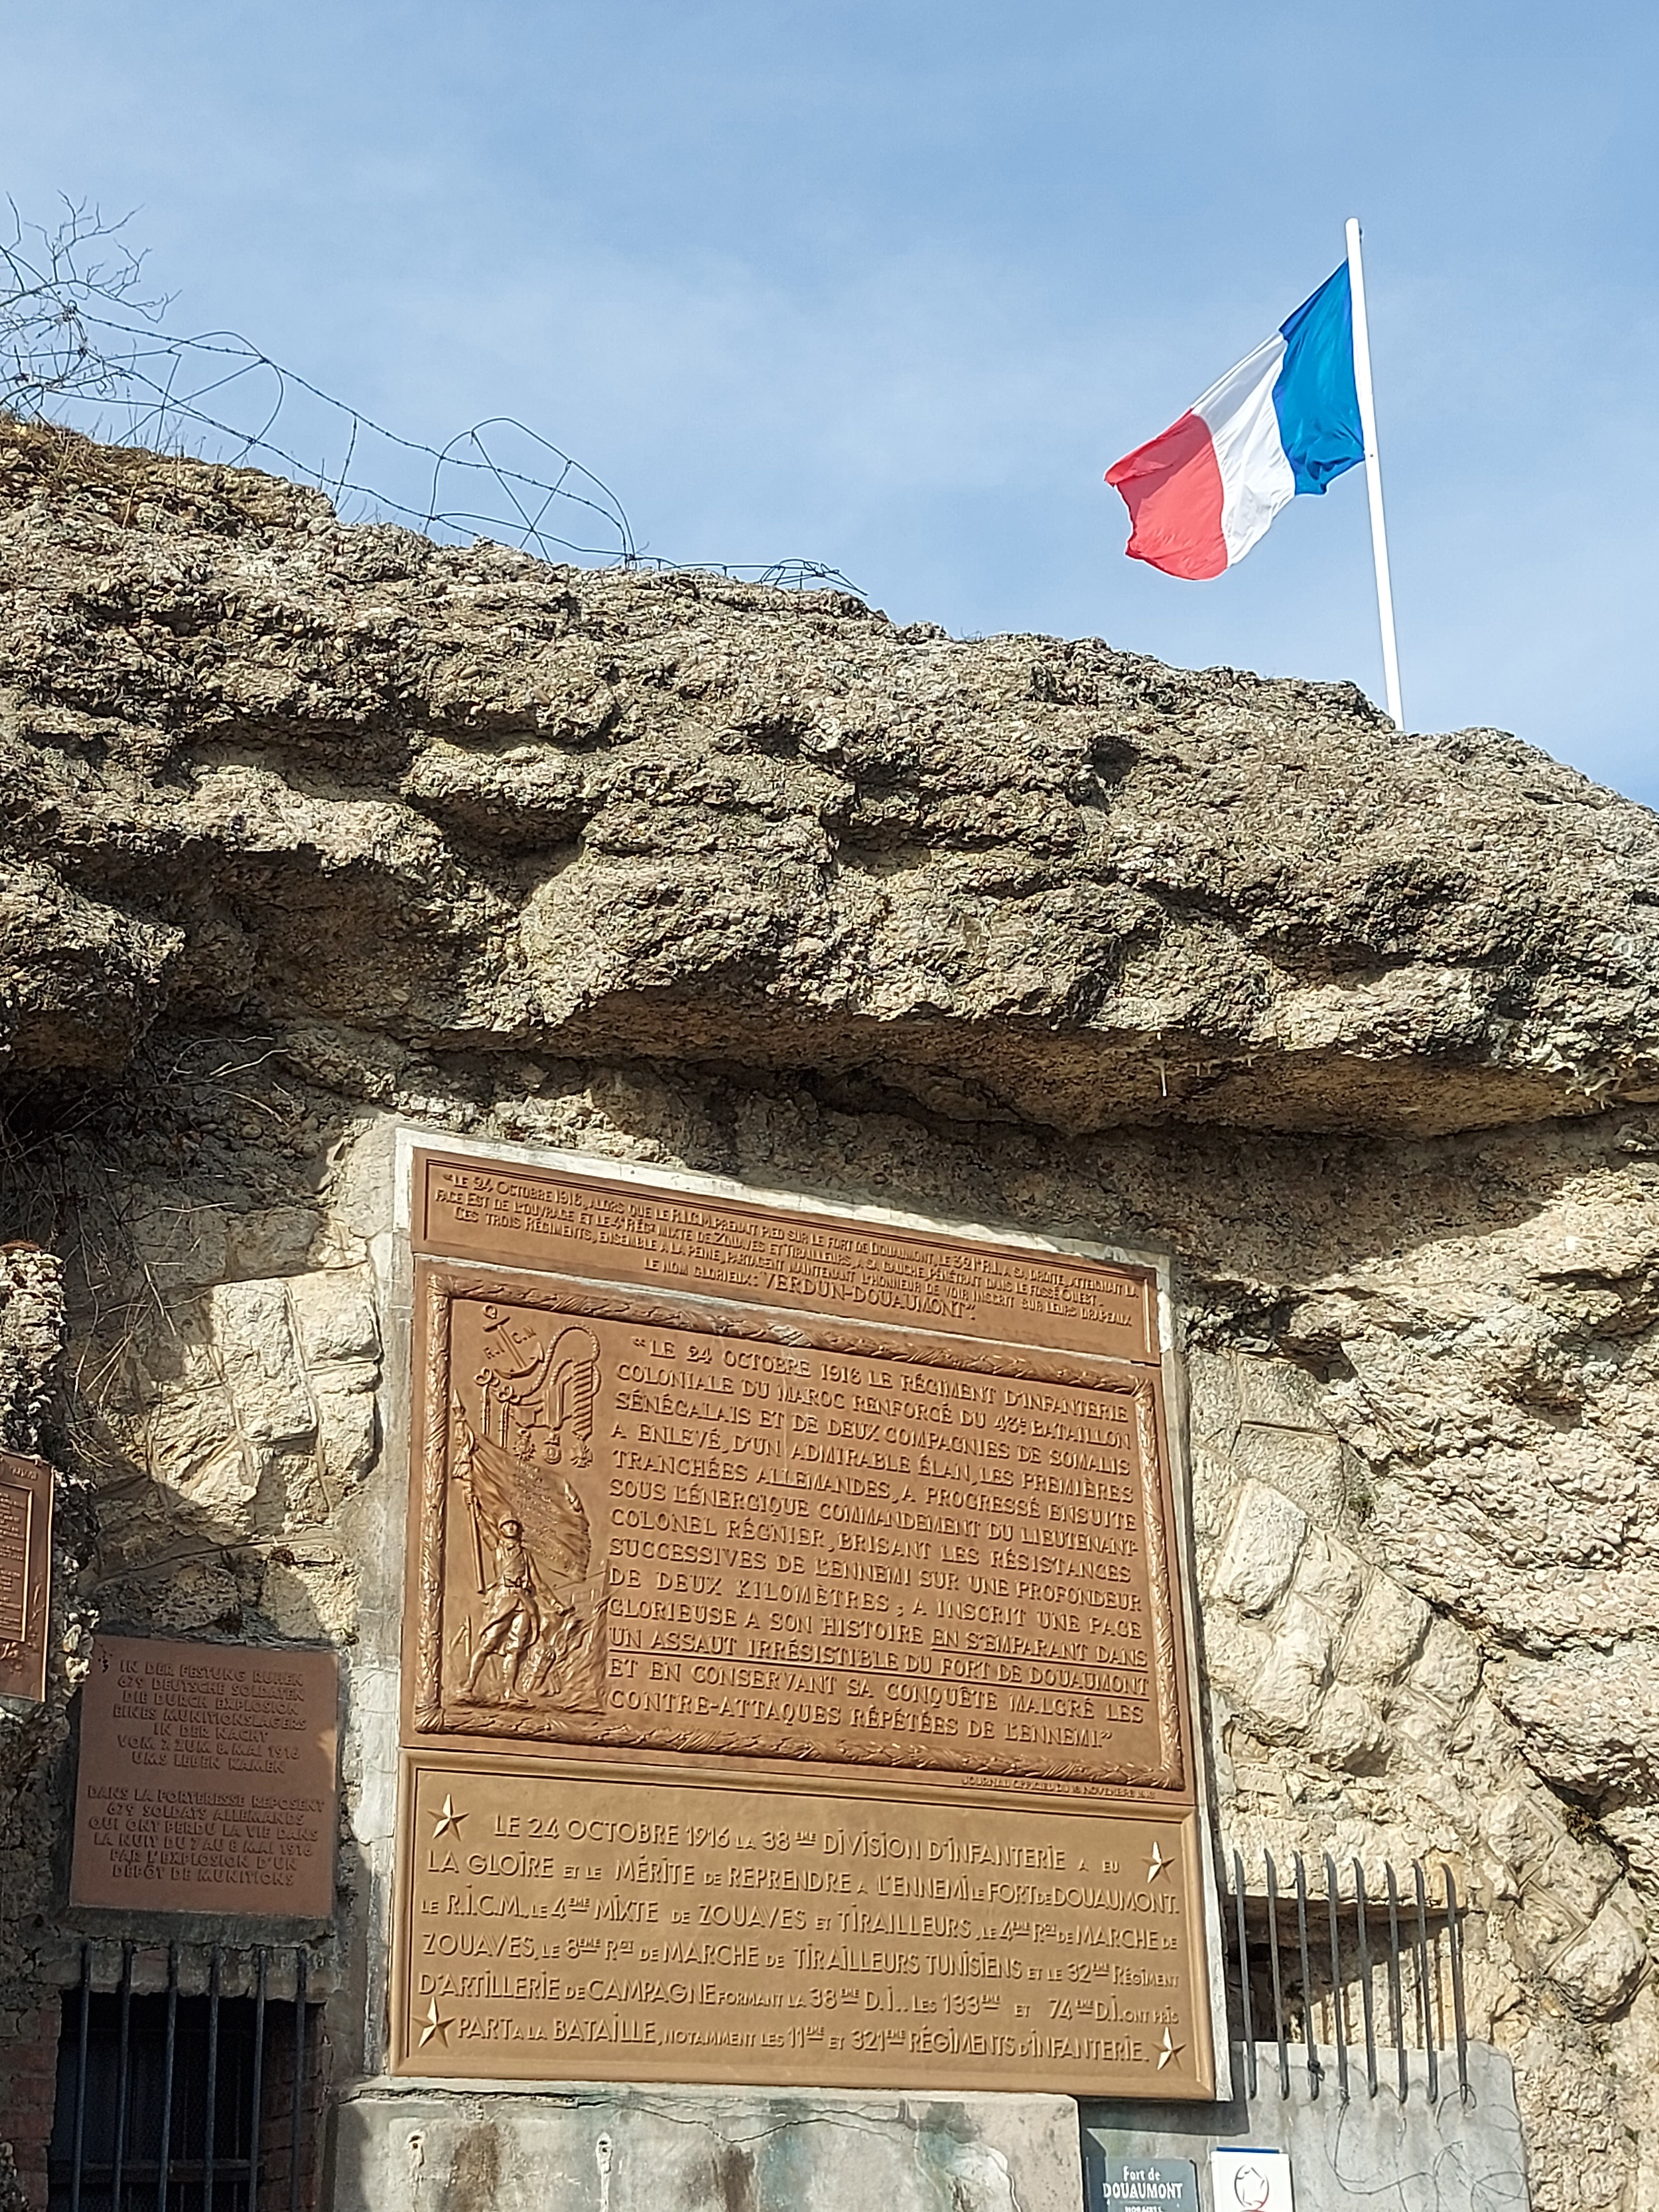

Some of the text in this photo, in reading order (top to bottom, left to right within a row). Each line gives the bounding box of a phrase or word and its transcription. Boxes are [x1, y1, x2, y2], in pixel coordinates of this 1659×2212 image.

[496, 1180, 552, 1202] OCTOBRE
[644, 1257, 659, 1272] LE
[662, 1260, 687, 1276] NOM
[687, 1343, 712, 1364] 24
[723, 1349, 810, 1378] OCTOBRE
[820, 1362, 861, 1385] 1916
[868, 1370, 893, 1390] LE
[901, 1371, 996, 1405] RÉGIMENT
[1004, 1389, 1128, 1423] D'INFANTERIE
[617, 1361, 733, 1395] COLONIALE
[742, 1379, 769, 1400] DU
[778, 1384, 844, 1411] MAROC
[852, 1390, 952, 1426] RENFORCÉ
[960, 1409, 986, 1430] DU
[1030, 1419, 1131, 1450] BATAILLON
[615, 1386, 1130, 1476] SÉNÉGALAIS ET DE DEUX COMPAGNIES DE SOMALIS
[611, 1418, 1134, 1504] A ENLEVÉ, D'UN ADMIRABLE ÉLAN, LES PREMIÈRES
[613, 1444, 1136, 1531] TRANCHÉES ALLEMANDES, A PROGRESSÉ ENSUITE
[610, 1476, 666, 1502] SOUS
[673, 1481, 809, 1520] L'ÉNERGIQUE
[817, 1502, 981, 1539] COMMANDEMENT
[987, 1522, 1013, 1543] DU
[610, 1506, 1131, 1583] COLONEL RÉGNIER, BRISANT LES RÉSISTANCES
[609, 1535, 1141, 1612] SUCCESSIVES DE L'ENNEMI SUR UNE PROFONDEUR
[609, 1565, 641, 1588] DE
[657, 1570, 722, 1596] DEUX
[912, 1598, 927, 1618] A
[937, 1600, 1027, 1628] INSCRIT
[1037, 1611, 1080, 1634] UNE
[1089, 1616, 1141, 1640] PAGE
[608, 1595, 1147, 1668] GLORIEUSE A SON HISTOIRE EN S'EMPARANT DANS
[119, 1659, 303, 1688] IN DER FESTUNG RUHEN
[608, 1625, 1149, 1696] UN ASSAUT IRRÉSISTIBLE DU FORT DE DOUAUMONT
[117, 1674, 305, 1703] 679 DEUTSCHE SOLDATEN
[122, 1689, 299, 1716] DIE DURCH EXPLOSION
[608, 1656, 1143, 1724] ET EN CONSERVANT SA CONQUÊTE MALGRÉ LES
[113, 1704, 307, 1733] EINES MUNITIONSLAGERS
[153, 1722, 268, 1744] IN DER NACHT
[609, 1686, 841, 1729] CONTRE-ATTAQUES
[849, 1703, 958, 1736] RÉPÉTÉES
[966, 1718, 995, 1739] DE
[117, 1734, 155, 1750] VOM
[175, 1739, 211, 1754] ZUM
[232, 1743, 262, 1758] MAI
[268, 1745, 300, 1760] 1916
[131, 1750, 285, 1774] UMS LEBEN KAMEN
[962, 1776, 1009, 1788] JOURNAL
[494, 1814, 520, 1837] LE
[528, 1816, 560, 1839] 24
[565, 1818, 678, 1846] OCTOBRE
[686, 1825, 730, 1849] 1916
[736, 1835, 756, 1850] LA
[1078, 1858, 1089, 1872] A
[1102, 1860, 1119, 1874] EU
[427, 1849, 460, 1874] LA
[564, 1865, 579, 1880] ET
[586, 1866, 601, 1881] LE
[704, 1871, 721, 1886] DE
[729, 1866, 852, 1895] REPRENDRE
[857, 1880, 868, 1895] A
[971, 1888, 984, 1902] LE
[987, 1882, 1037, 1905] FORT
[1037, 1892, 1052, 1906] DE
[1052, 1886, 1180, 1914] DOUAUMONT.
[421, 1930, 539, 1960] ZOUAVES,
[564, 1984, 585, 2000] DE
[457, 2014, 512, 2041] PART
[512, 2025, 527, 2040] A
[528, 2025, 547, 2041] LA
[1103, 2181, 1183, 2199] DOUAUMONT
[1123, 2166, 1161, 2181] Fort de
